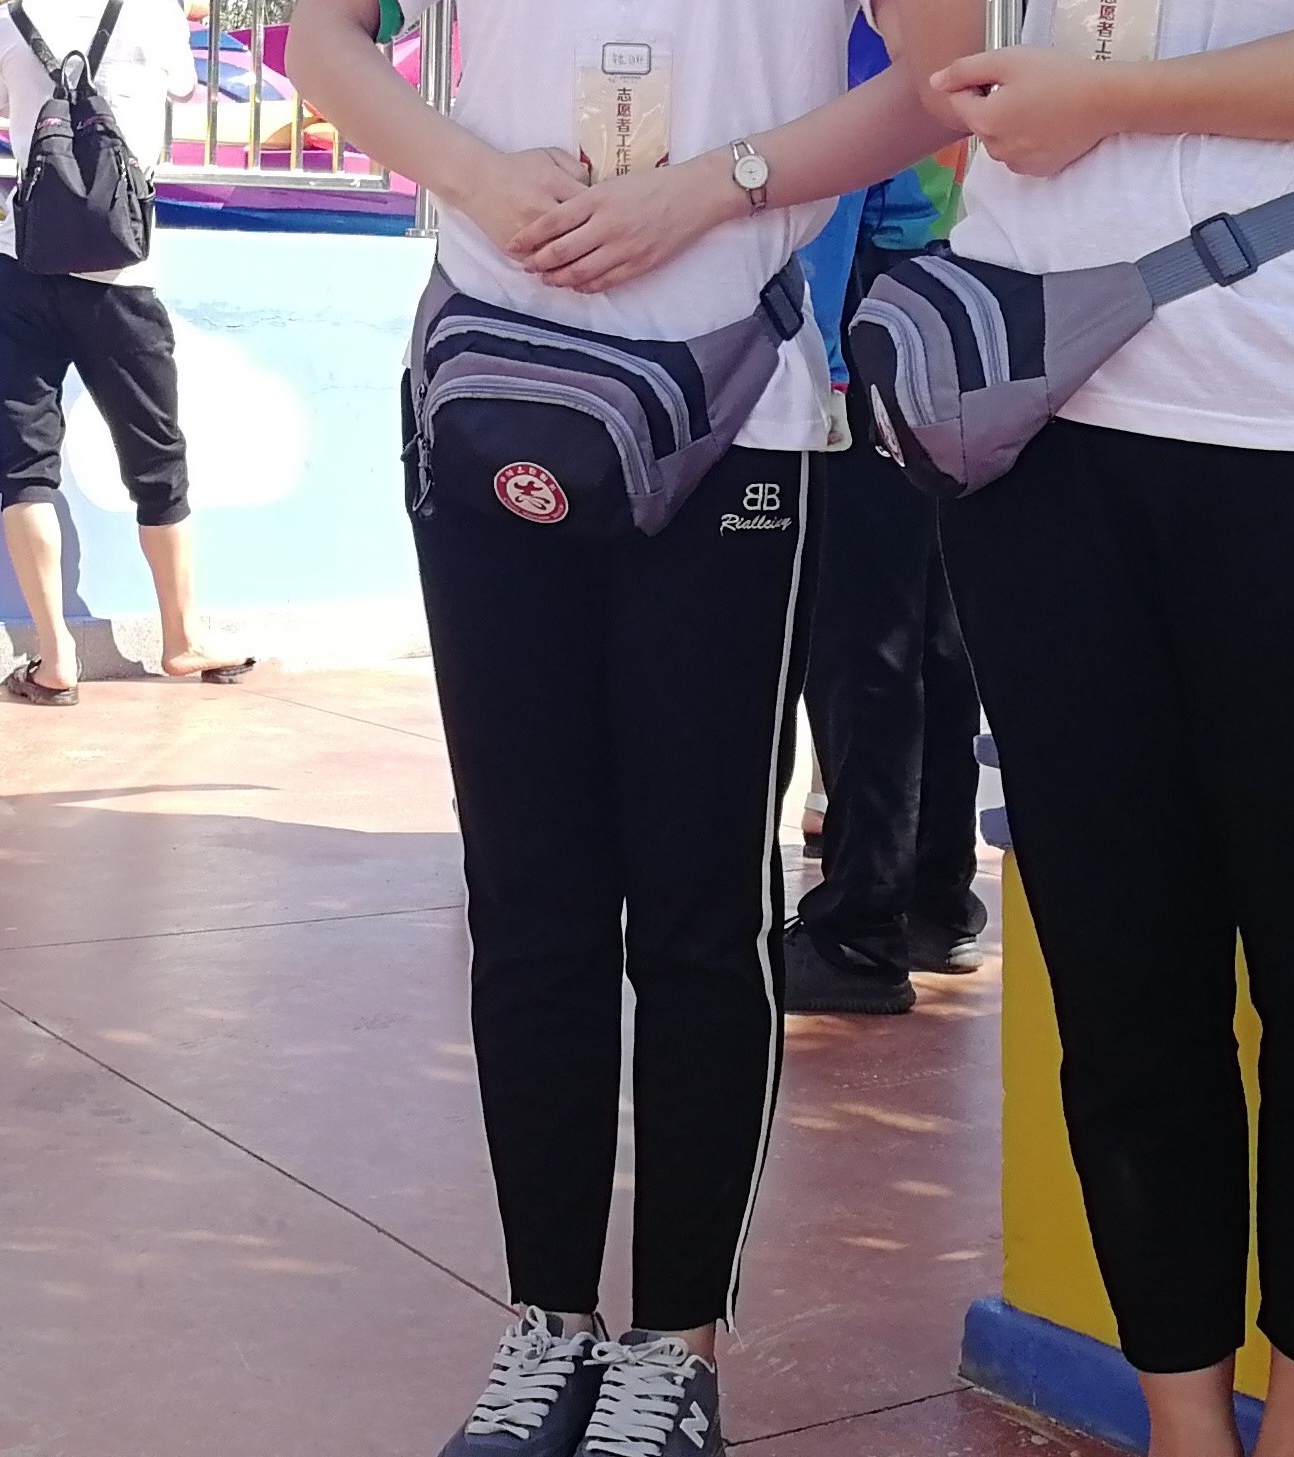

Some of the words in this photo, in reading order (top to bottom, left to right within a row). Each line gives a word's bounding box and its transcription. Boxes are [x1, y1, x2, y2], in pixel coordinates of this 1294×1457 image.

[616, 87, 632, 176] 志愿者工作证
